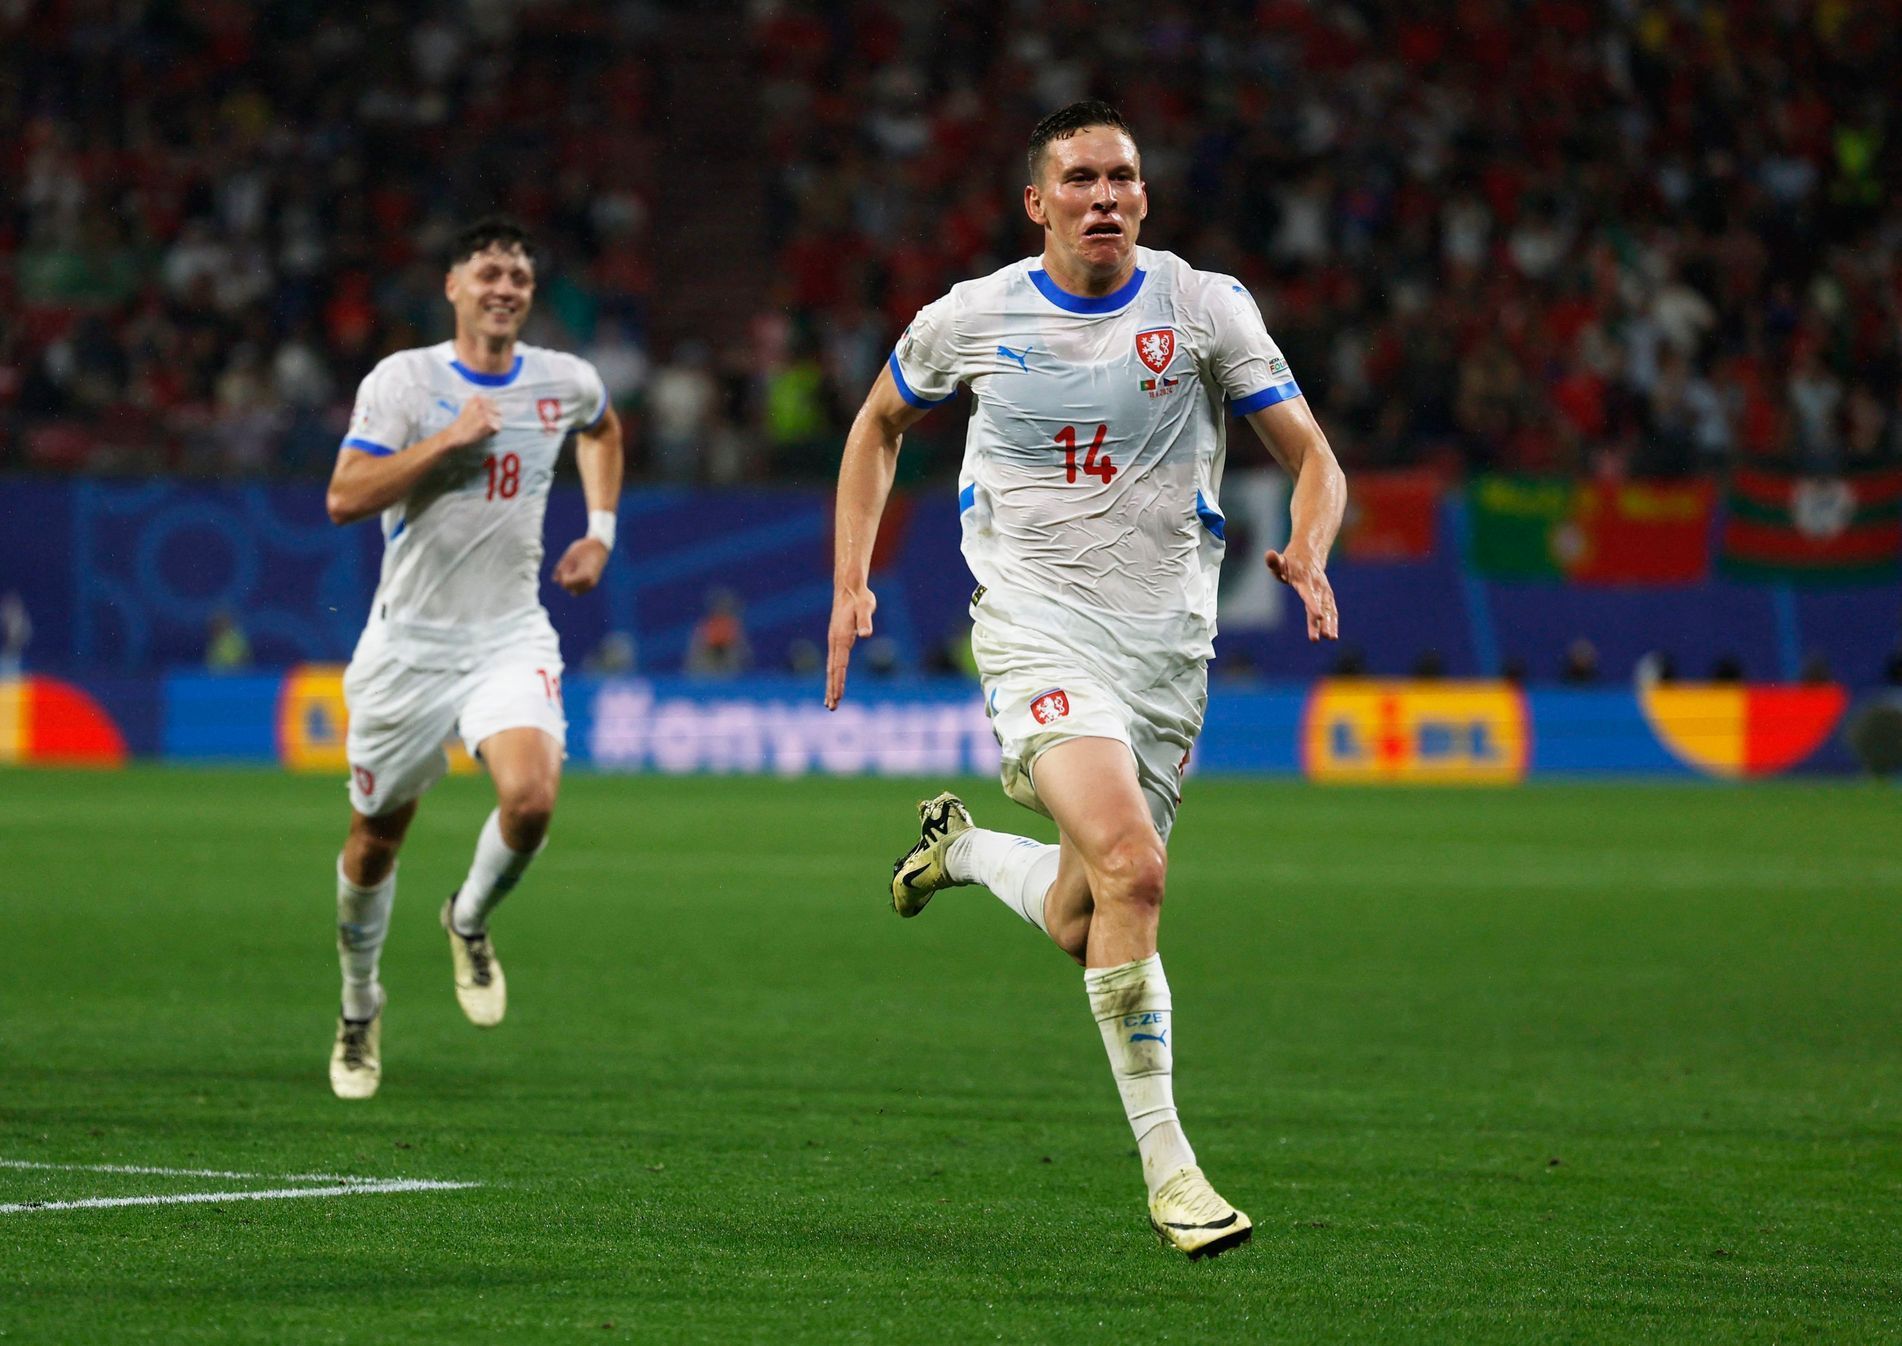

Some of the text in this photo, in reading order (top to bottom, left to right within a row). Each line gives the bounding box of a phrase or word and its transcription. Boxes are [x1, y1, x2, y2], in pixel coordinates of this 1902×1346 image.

[482, 453, 520, 501] 18
[1054, 424, 1117, 484] 14
[1123, 1012, 1163, 1027] CZE
